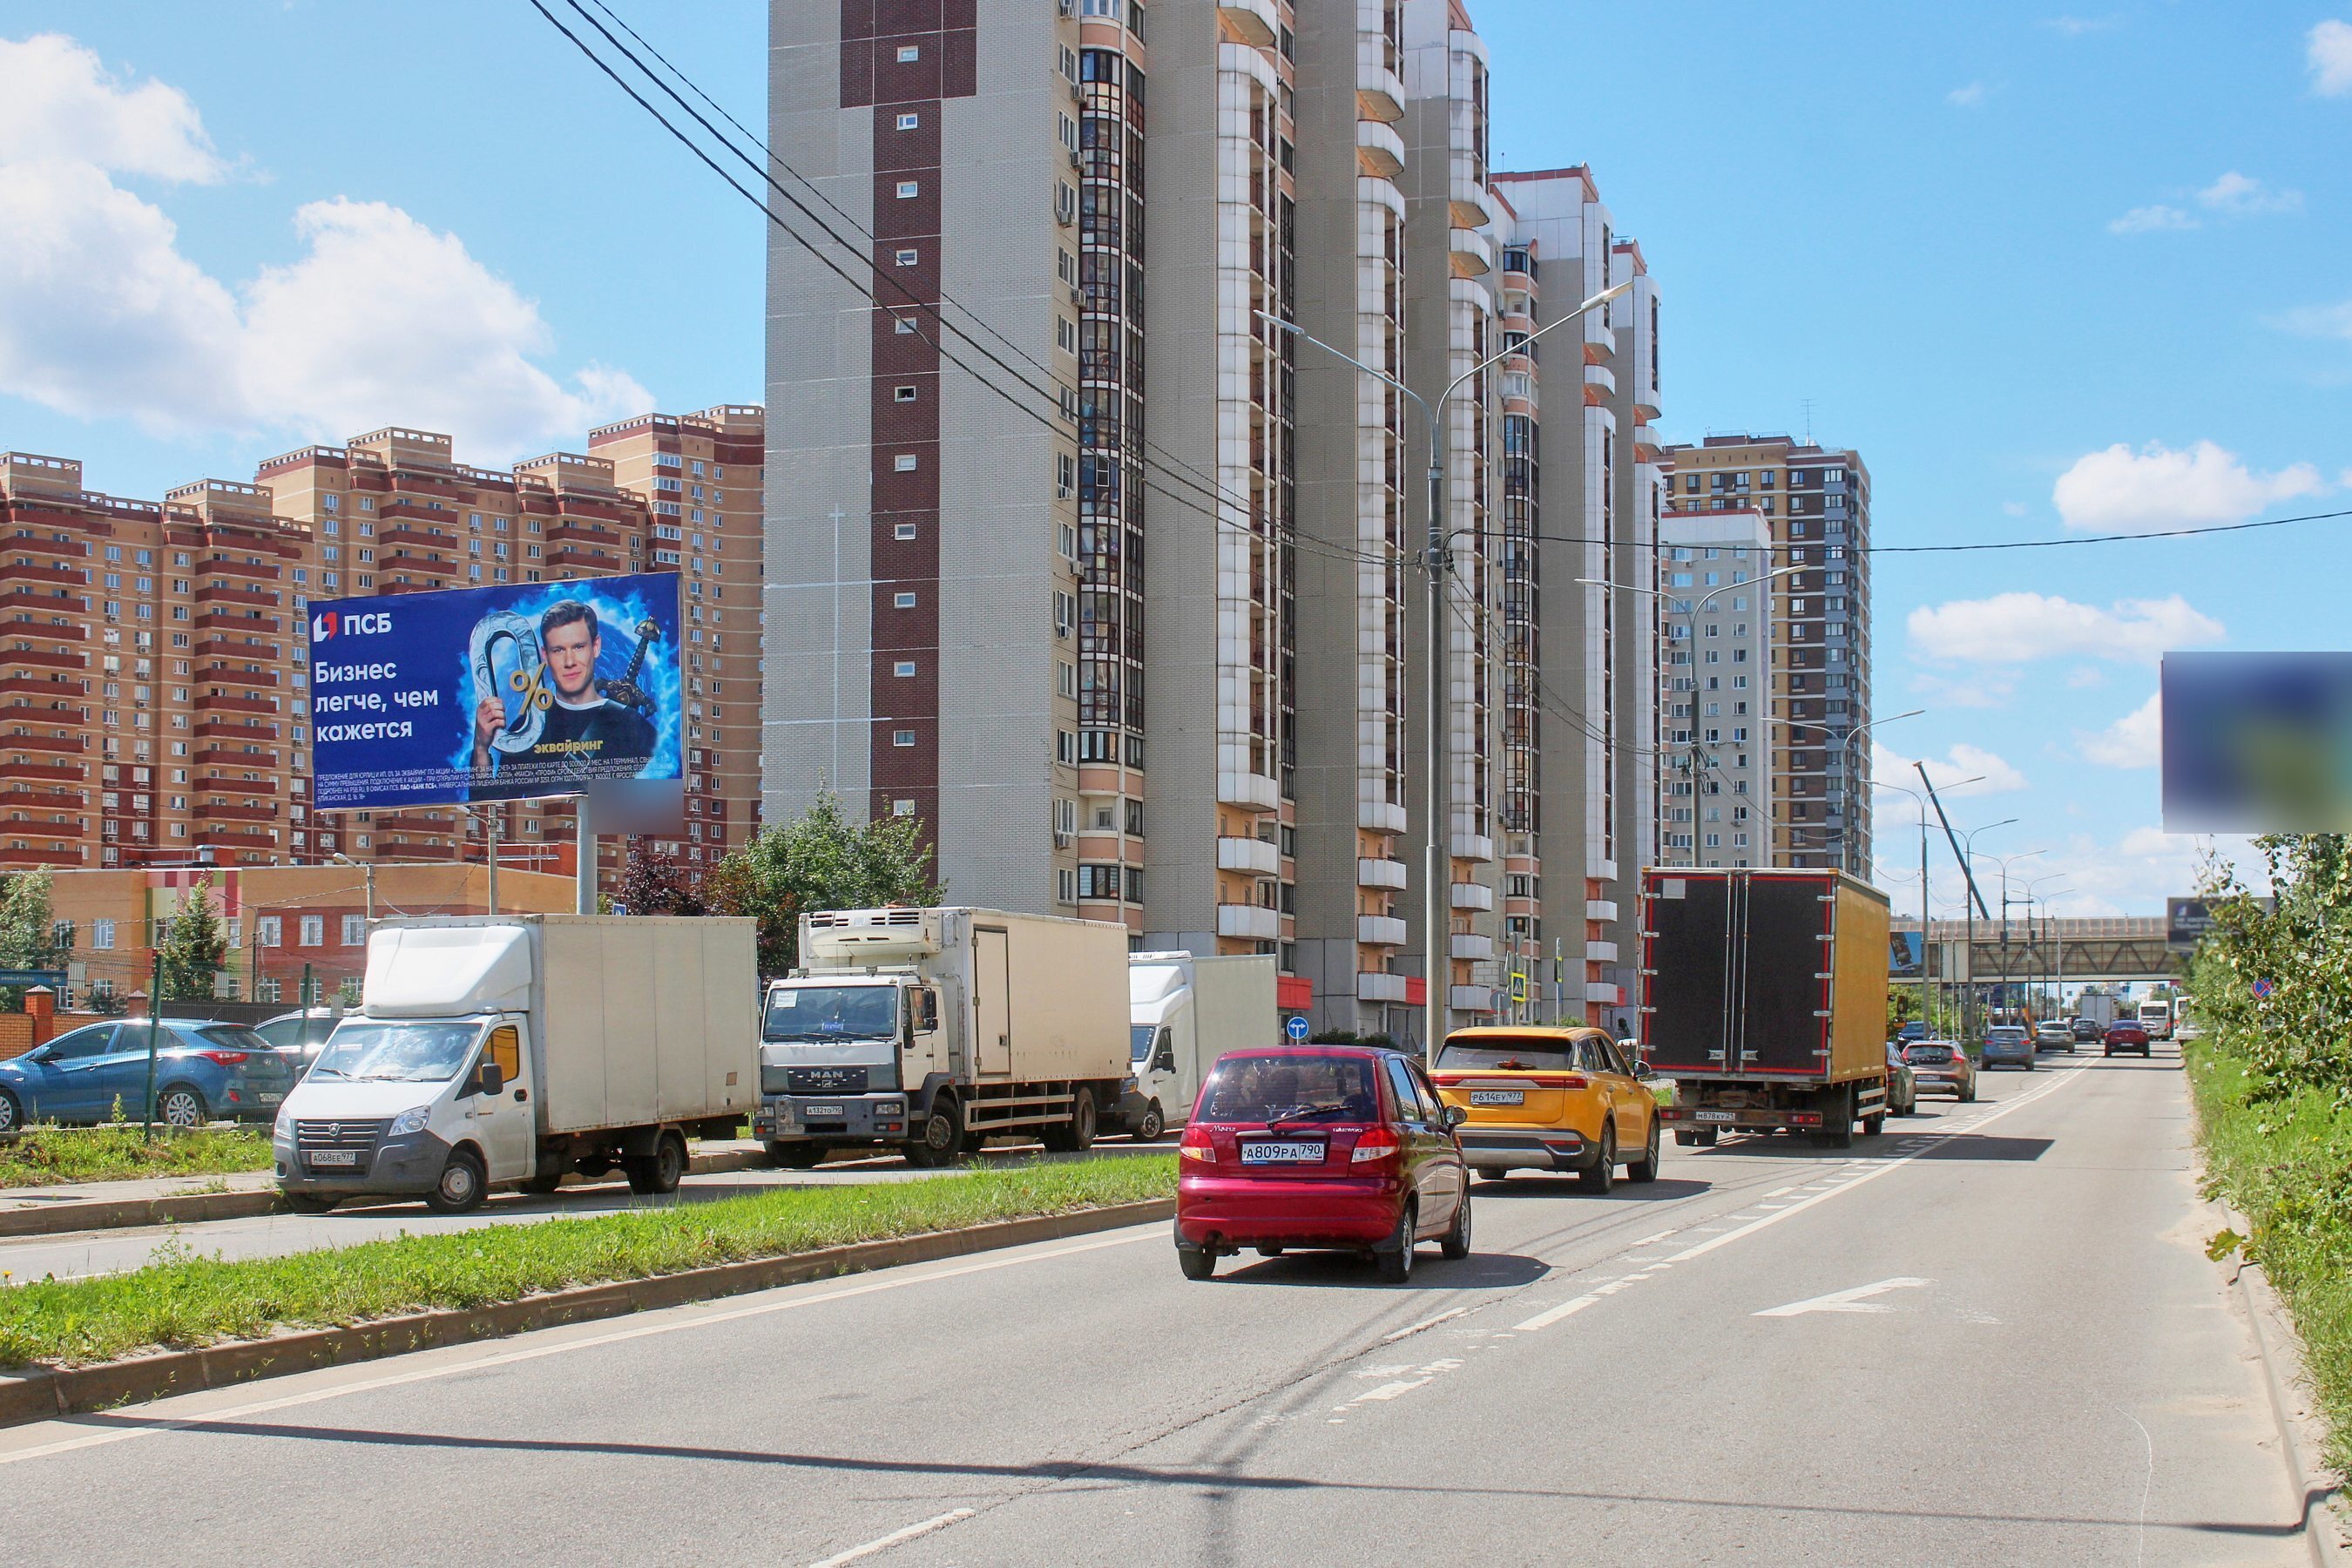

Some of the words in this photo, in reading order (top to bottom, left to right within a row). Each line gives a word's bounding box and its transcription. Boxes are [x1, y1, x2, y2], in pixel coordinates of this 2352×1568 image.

[344, 612, 392, 636] ПСБ
[315, 660, 397, 684] Бизнес
[315, 694, 389, 713] легче,
[394, 689, 438, 707] чем
[316, 719, 413, 743] кажется
[534, 738, 604, 756] эквайринг
[1301, 1144, 1321, 1155] 790
